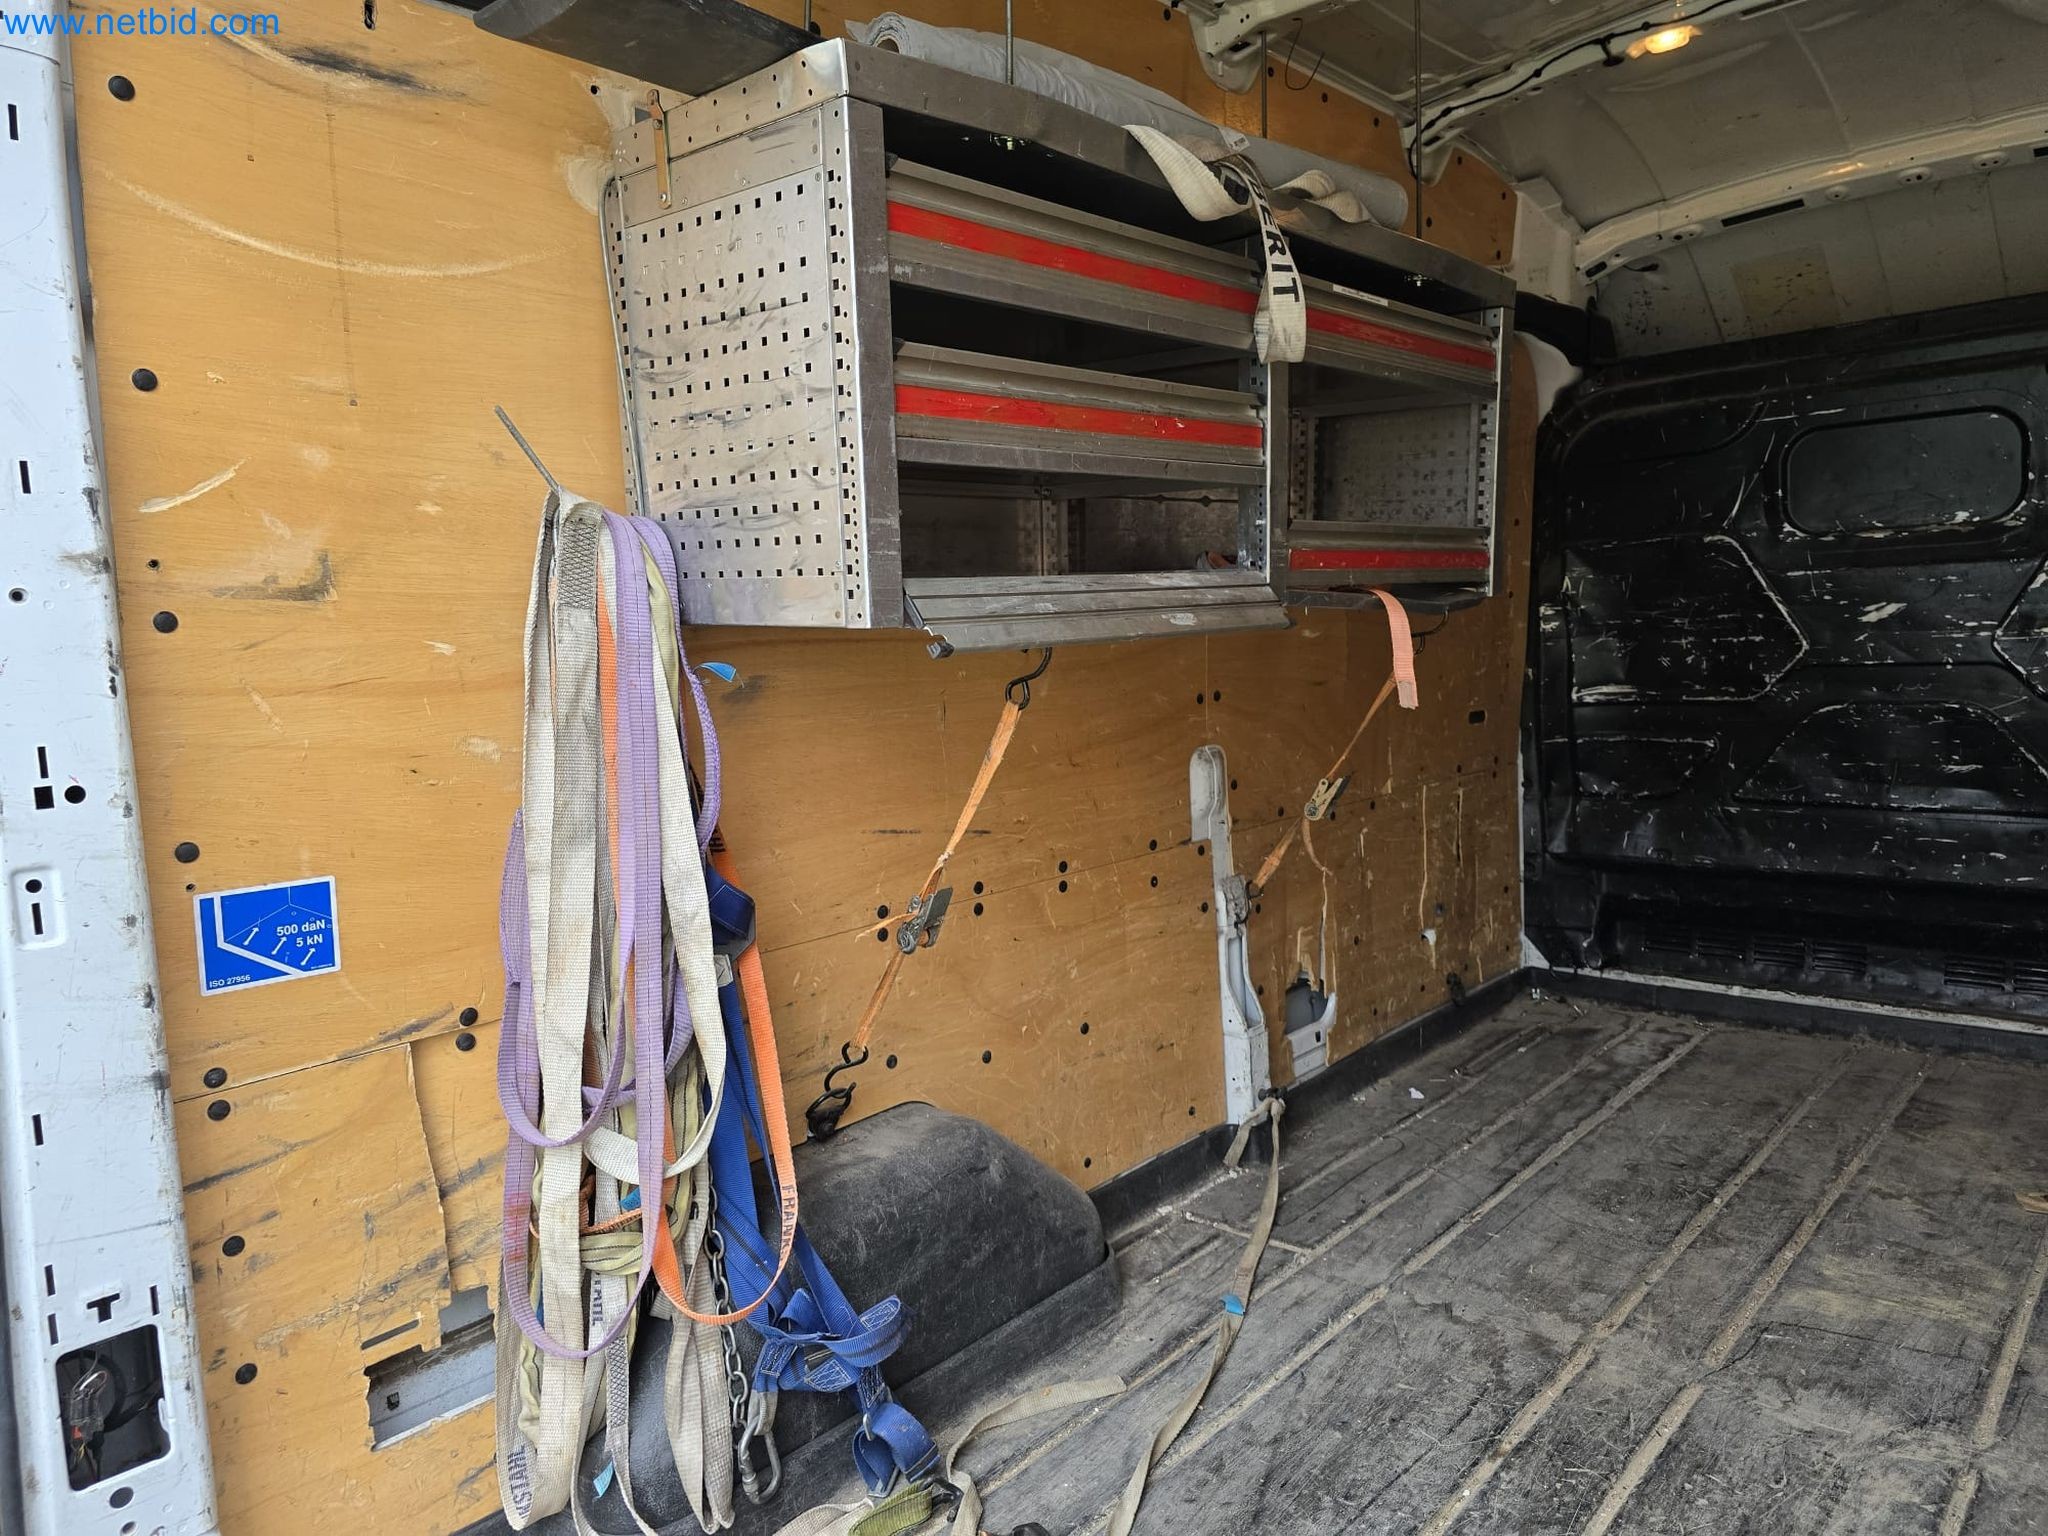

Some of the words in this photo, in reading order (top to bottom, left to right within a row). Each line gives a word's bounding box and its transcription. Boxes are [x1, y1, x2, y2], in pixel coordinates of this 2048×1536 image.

[277, 924, 298, 936] 500
[302, 920, 326, 932] daN
[296, 938, 304, 947] 5
[307, 934, 323, 946] kN
[209, 979, 225, 988] ISO
[226, 974, 251, 986] 27956
